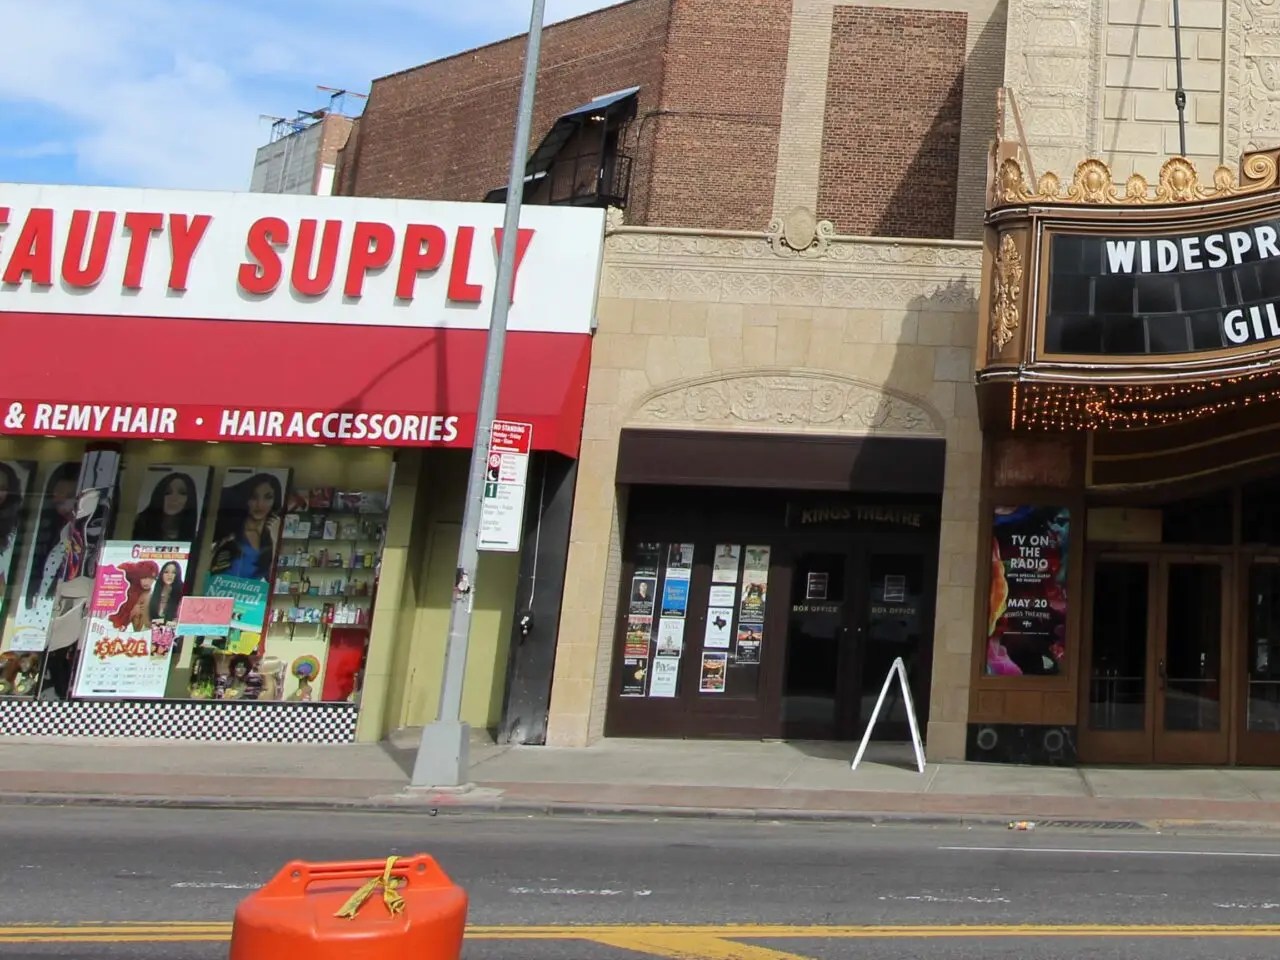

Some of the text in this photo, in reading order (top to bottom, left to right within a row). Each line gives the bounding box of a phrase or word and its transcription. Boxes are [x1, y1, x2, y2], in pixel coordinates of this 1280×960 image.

[0, 206, 536, 304] AUTY SUPPLY
[4, 403, 459, 442] & REMY HAIR HAIR ACCESSORIES
[802, 507, 921, 528] KINGS THEATRE
[1011, 535, 1049, 546] TV ON
[1019, 546, 1040, 557] THE
[1010, 558, 1048, 569] RADIO
[213, 575, 261, 593] Peruvian
[1007, 598, 1047, 608] MAY 20
[889, 607, 916, 615] OFFICE
